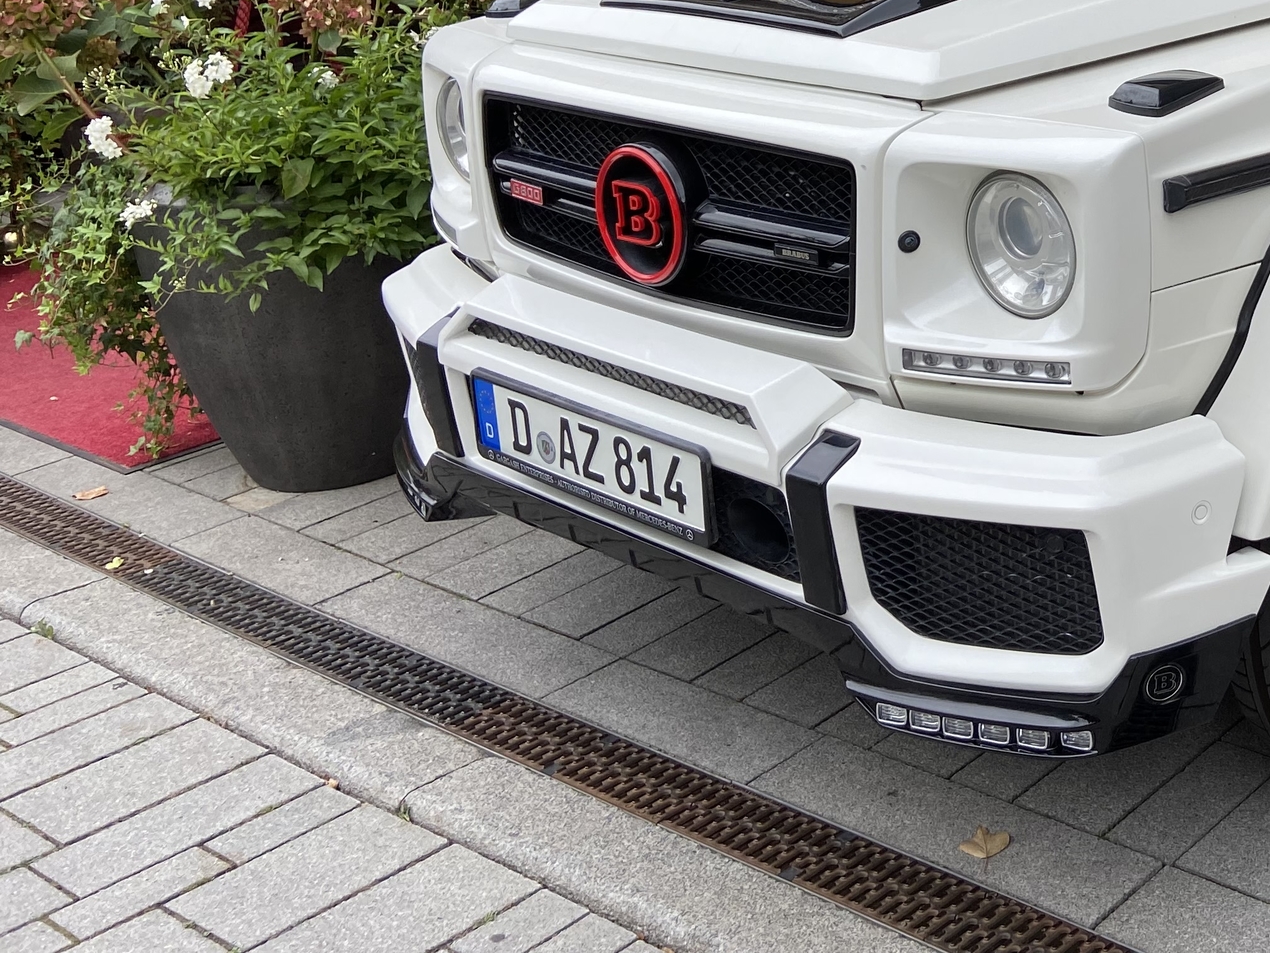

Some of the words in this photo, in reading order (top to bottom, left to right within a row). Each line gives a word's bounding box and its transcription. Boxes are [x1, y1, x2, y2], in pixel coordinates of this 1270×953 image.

[611, 179, 662, 247] B
[485, 422, 494, 439] D
[507, 398, 533, 455] D
[560, 416, 606, 485] AZ
[613, 436, 688, 514] 814
[628, 506, 636, 517] OF
